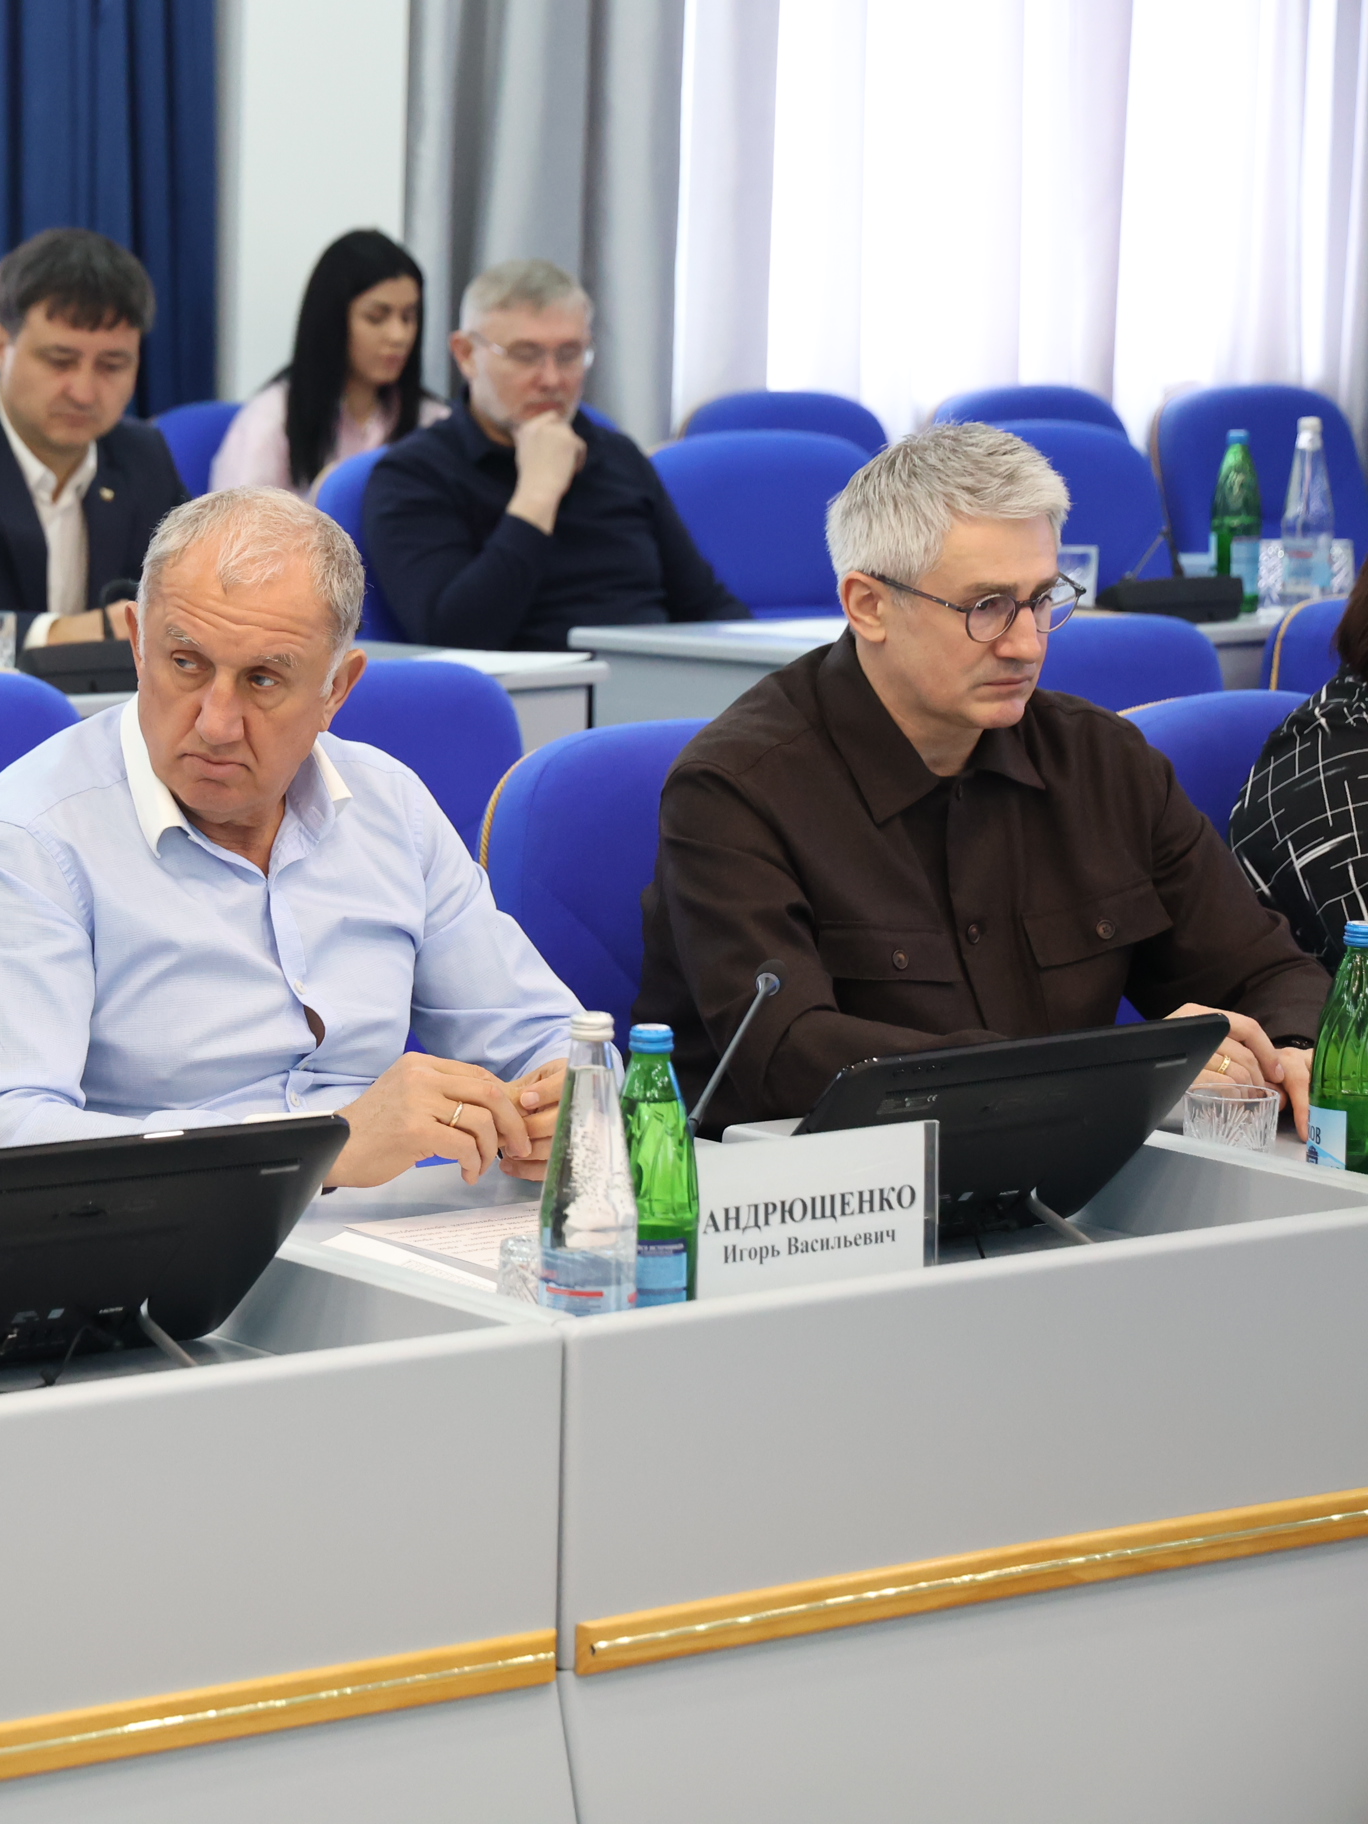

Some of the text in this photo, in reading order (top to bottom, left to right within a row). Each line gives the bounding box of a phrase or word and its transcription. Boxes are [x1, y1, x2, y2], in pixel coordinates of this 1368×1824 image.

[703, 1184, 917, 1235] АНДРЮЩЕНКО
[723, 1229, 896, 1265] Игорь Васильевич
